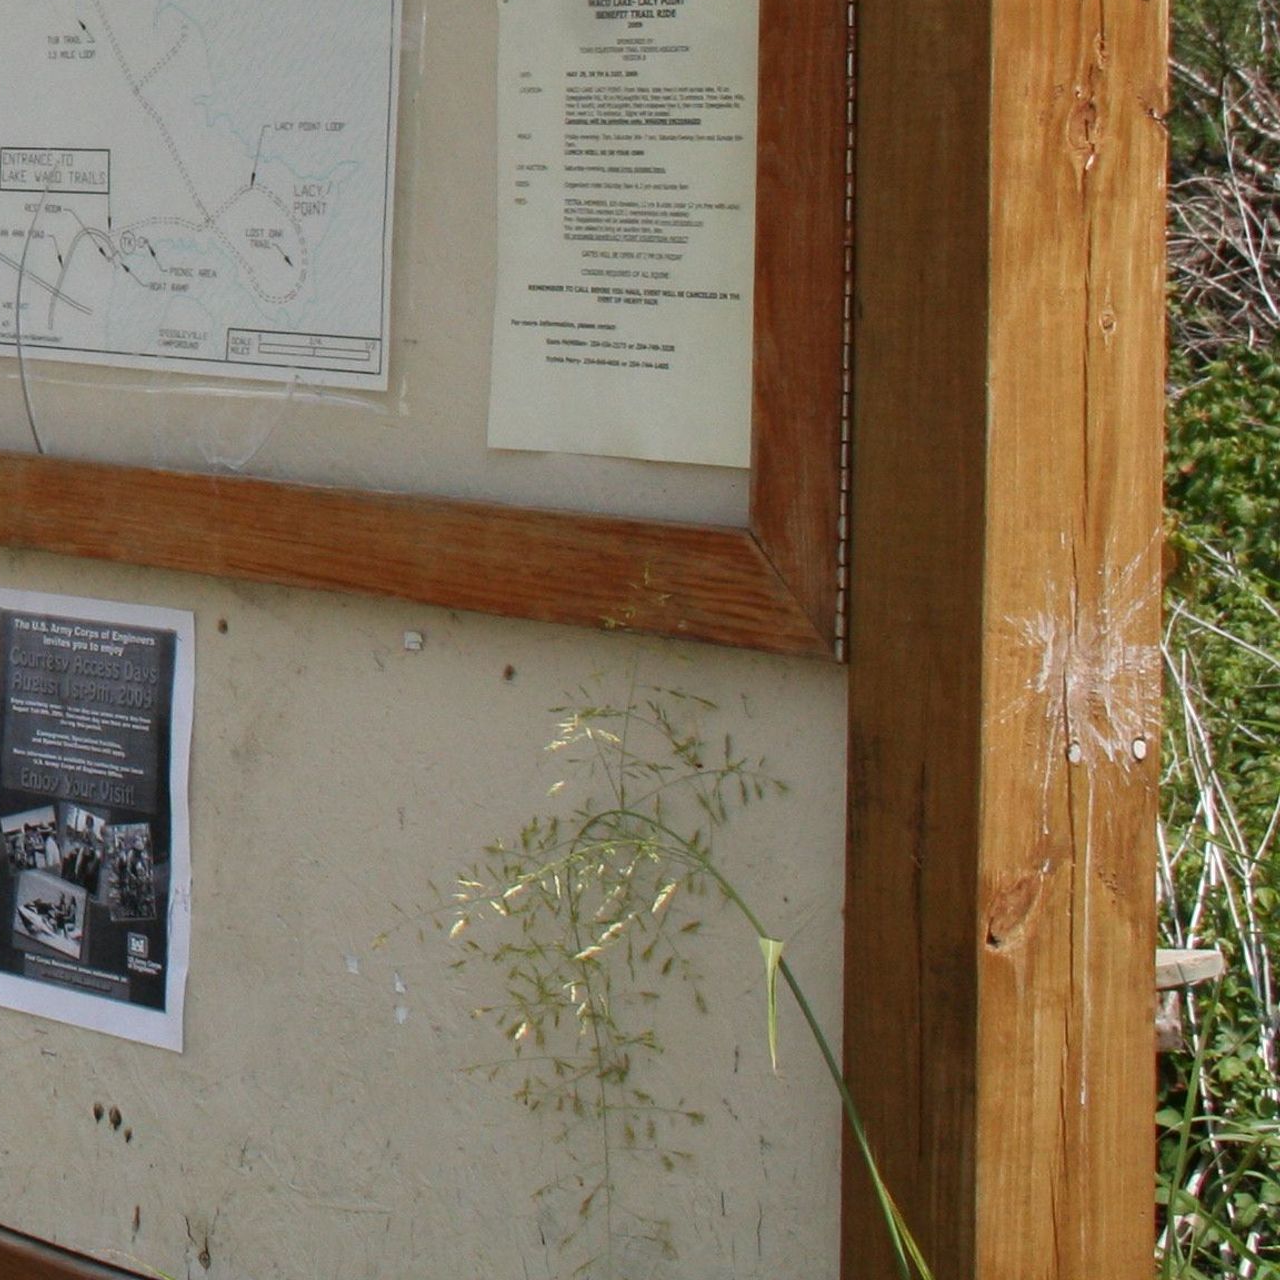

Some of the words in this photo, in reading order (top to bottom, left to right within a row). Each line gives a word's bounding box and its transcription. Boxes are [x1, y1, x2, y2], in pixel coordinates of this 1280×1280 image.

[596, 10, 628, 19] BENEFIT
[630, 10, 654, 18] TRAIL
[657, 9, 676, 18] RIDE
[2, 152, 53, 166] ENTRANCE
[60, 153, 74, 167] TO
[2, 170, 26, 183] LAKE
[69, 171, 106, 185] TRAILS
[293, 184, 323, 198] LACY
[293, 201, 327, 216] POINT
[574, 285, 589, 293] CALL
[14, 618, 30, 630] The
[32, 621, 48, 633] U.S.
[50, 624, 73, 637] Army
[74, 626, 99, 639] Corps
[101, 630, 110, 639] of
[112, 632, 156, 647] Engineers
[72, 641, 88, 651] you
[90, 642, 99, 652] to
[100, 646, 125, 657] enjoy
[10, 646, 70, 673] Courtesy
[73, 655, 120, 680] Access
[124, 660, 158, 684] Days
[12, 671, 61, 696] August
[116, 686, 152, 709] 2009
[20, 766, 59, 791] Enjoy
[64, 773, 96, 796] Your
[100, 779, 136, 806] Visit!
